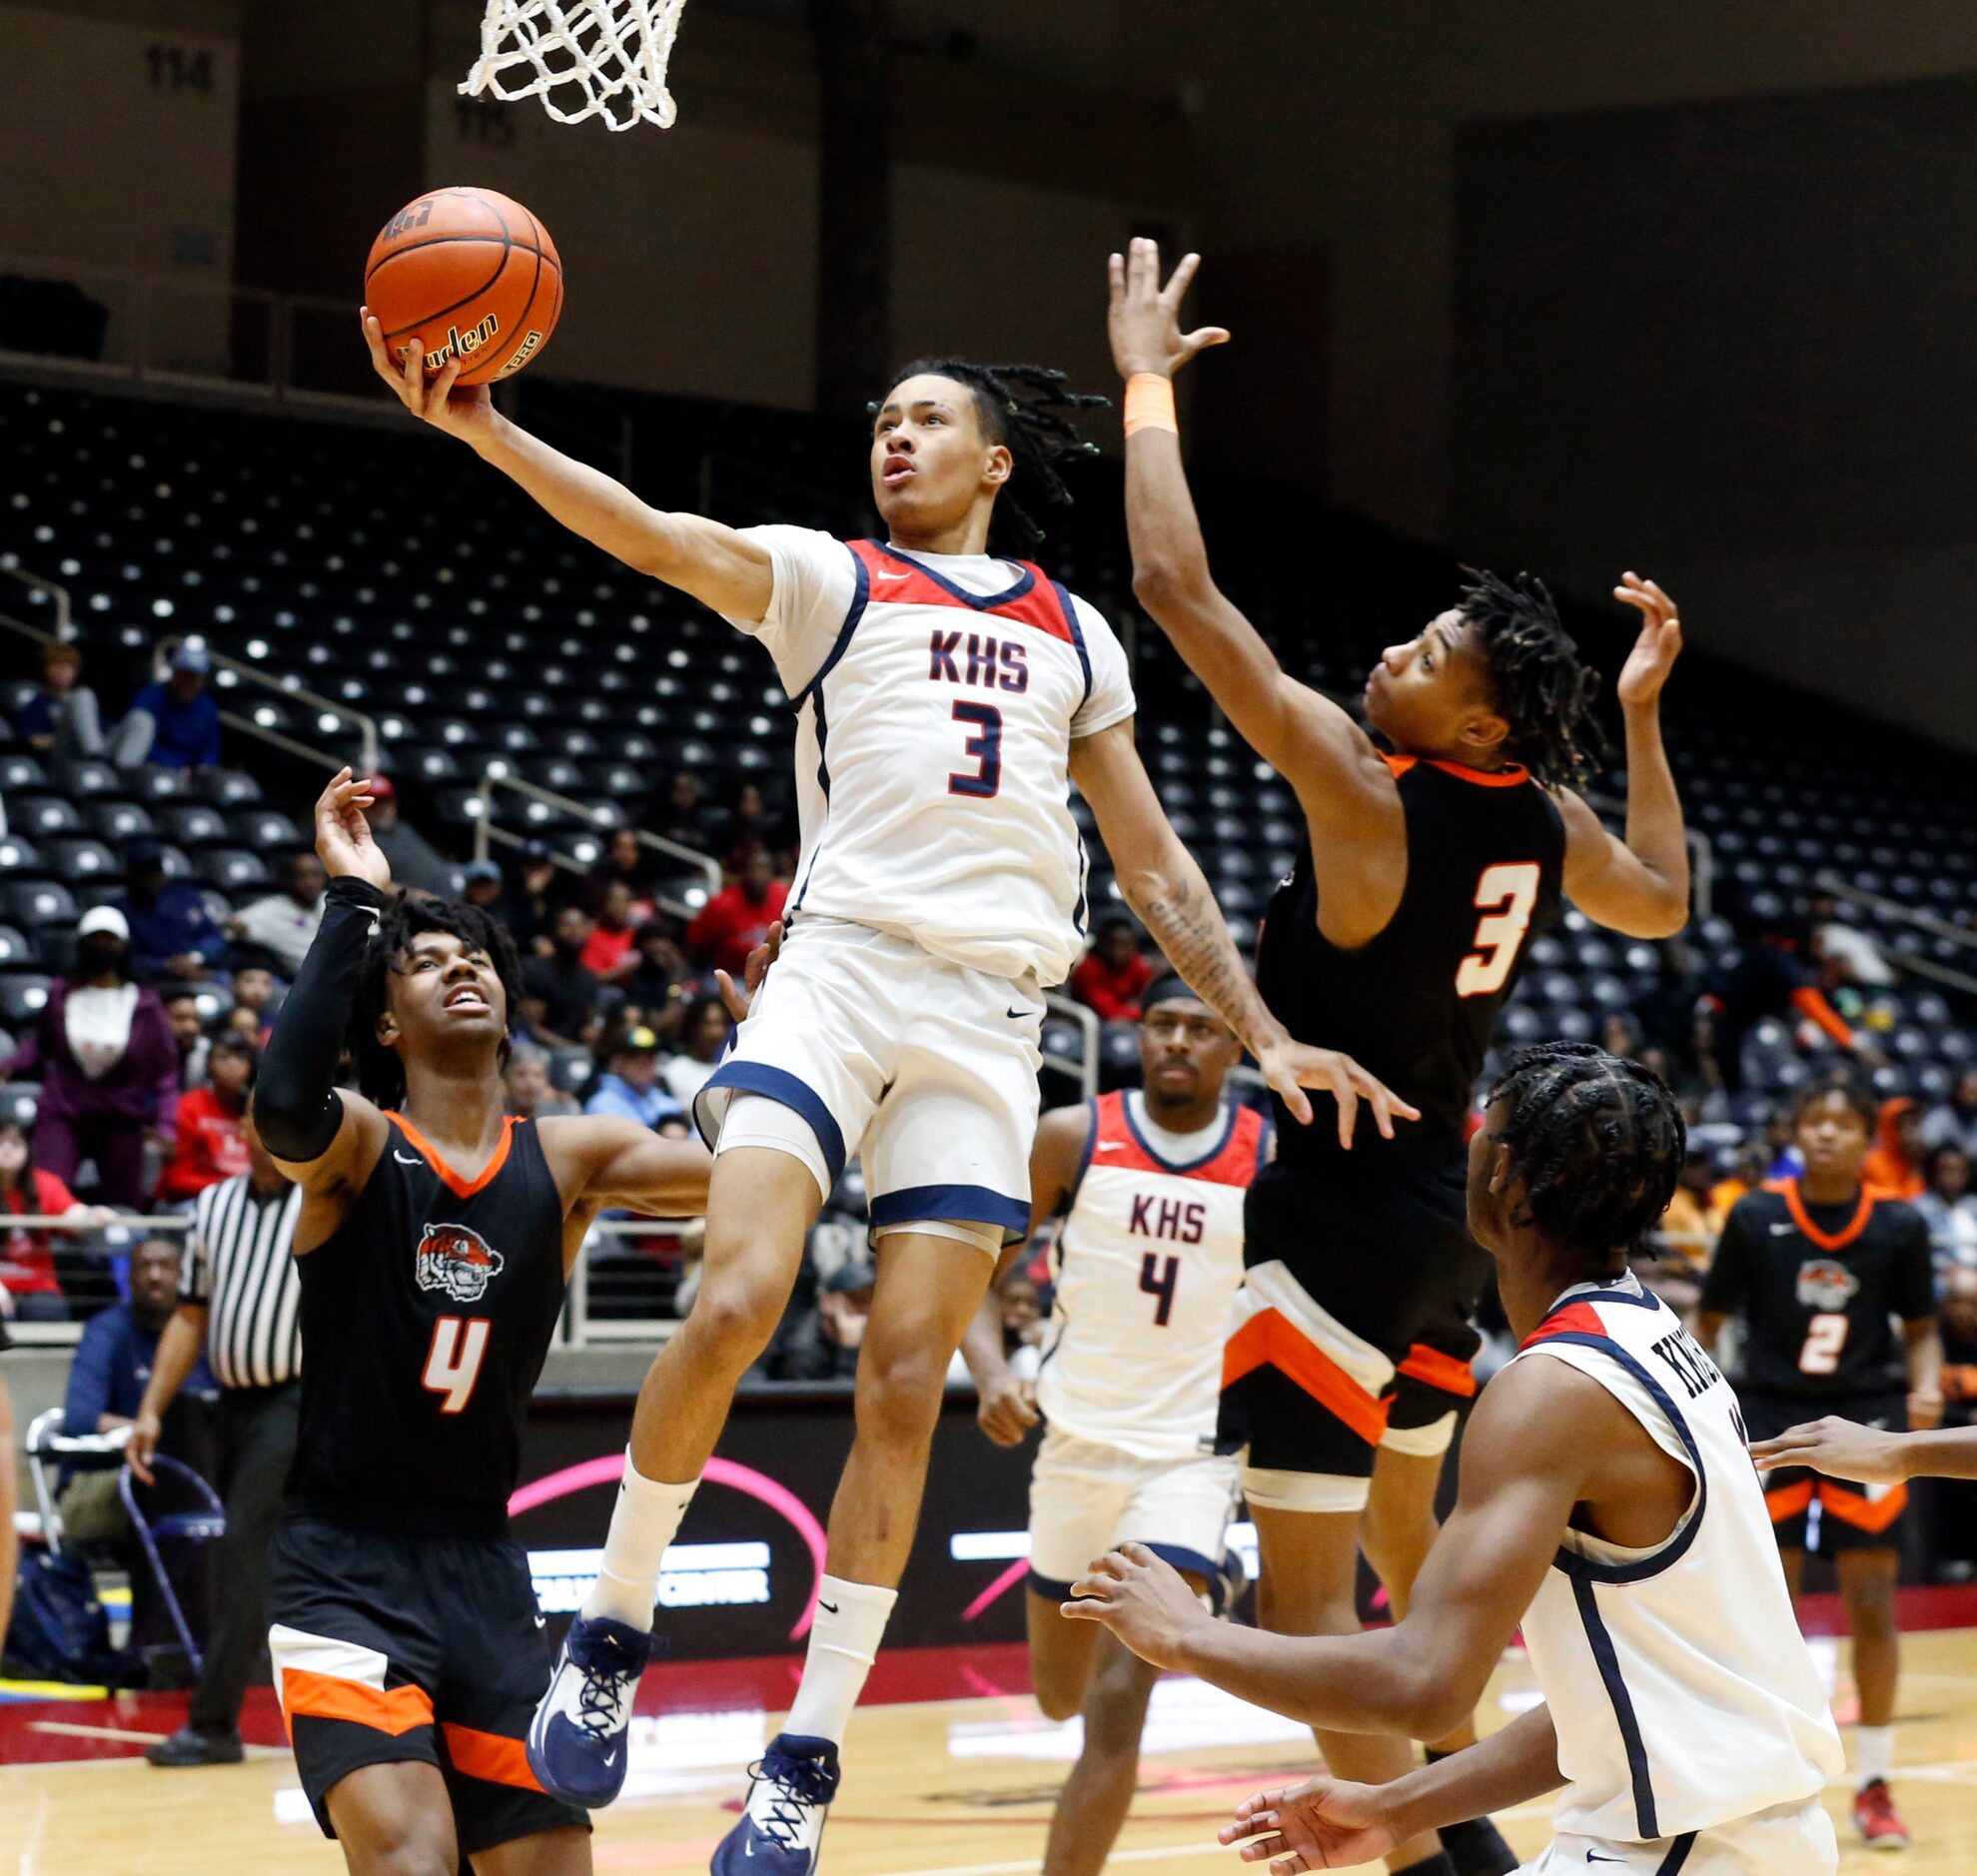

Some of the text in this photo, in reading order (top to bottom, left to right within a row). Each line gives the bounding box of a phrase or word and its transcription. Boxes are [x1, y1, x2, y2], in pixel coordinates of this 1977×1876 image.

[145, 45, 214, 91] 114
[929, 630, 1028, 694] KHS
[948, 699, 1003, 798] 3
[1455, 861, 1541, 998] 3
[1129, 1194, 1206, 1244] KHS
[1139, 1253, 1179, 1327] 4
[421, 1315, 492, 1413] 4
[1798, 1313, 1848, 1375] 2
